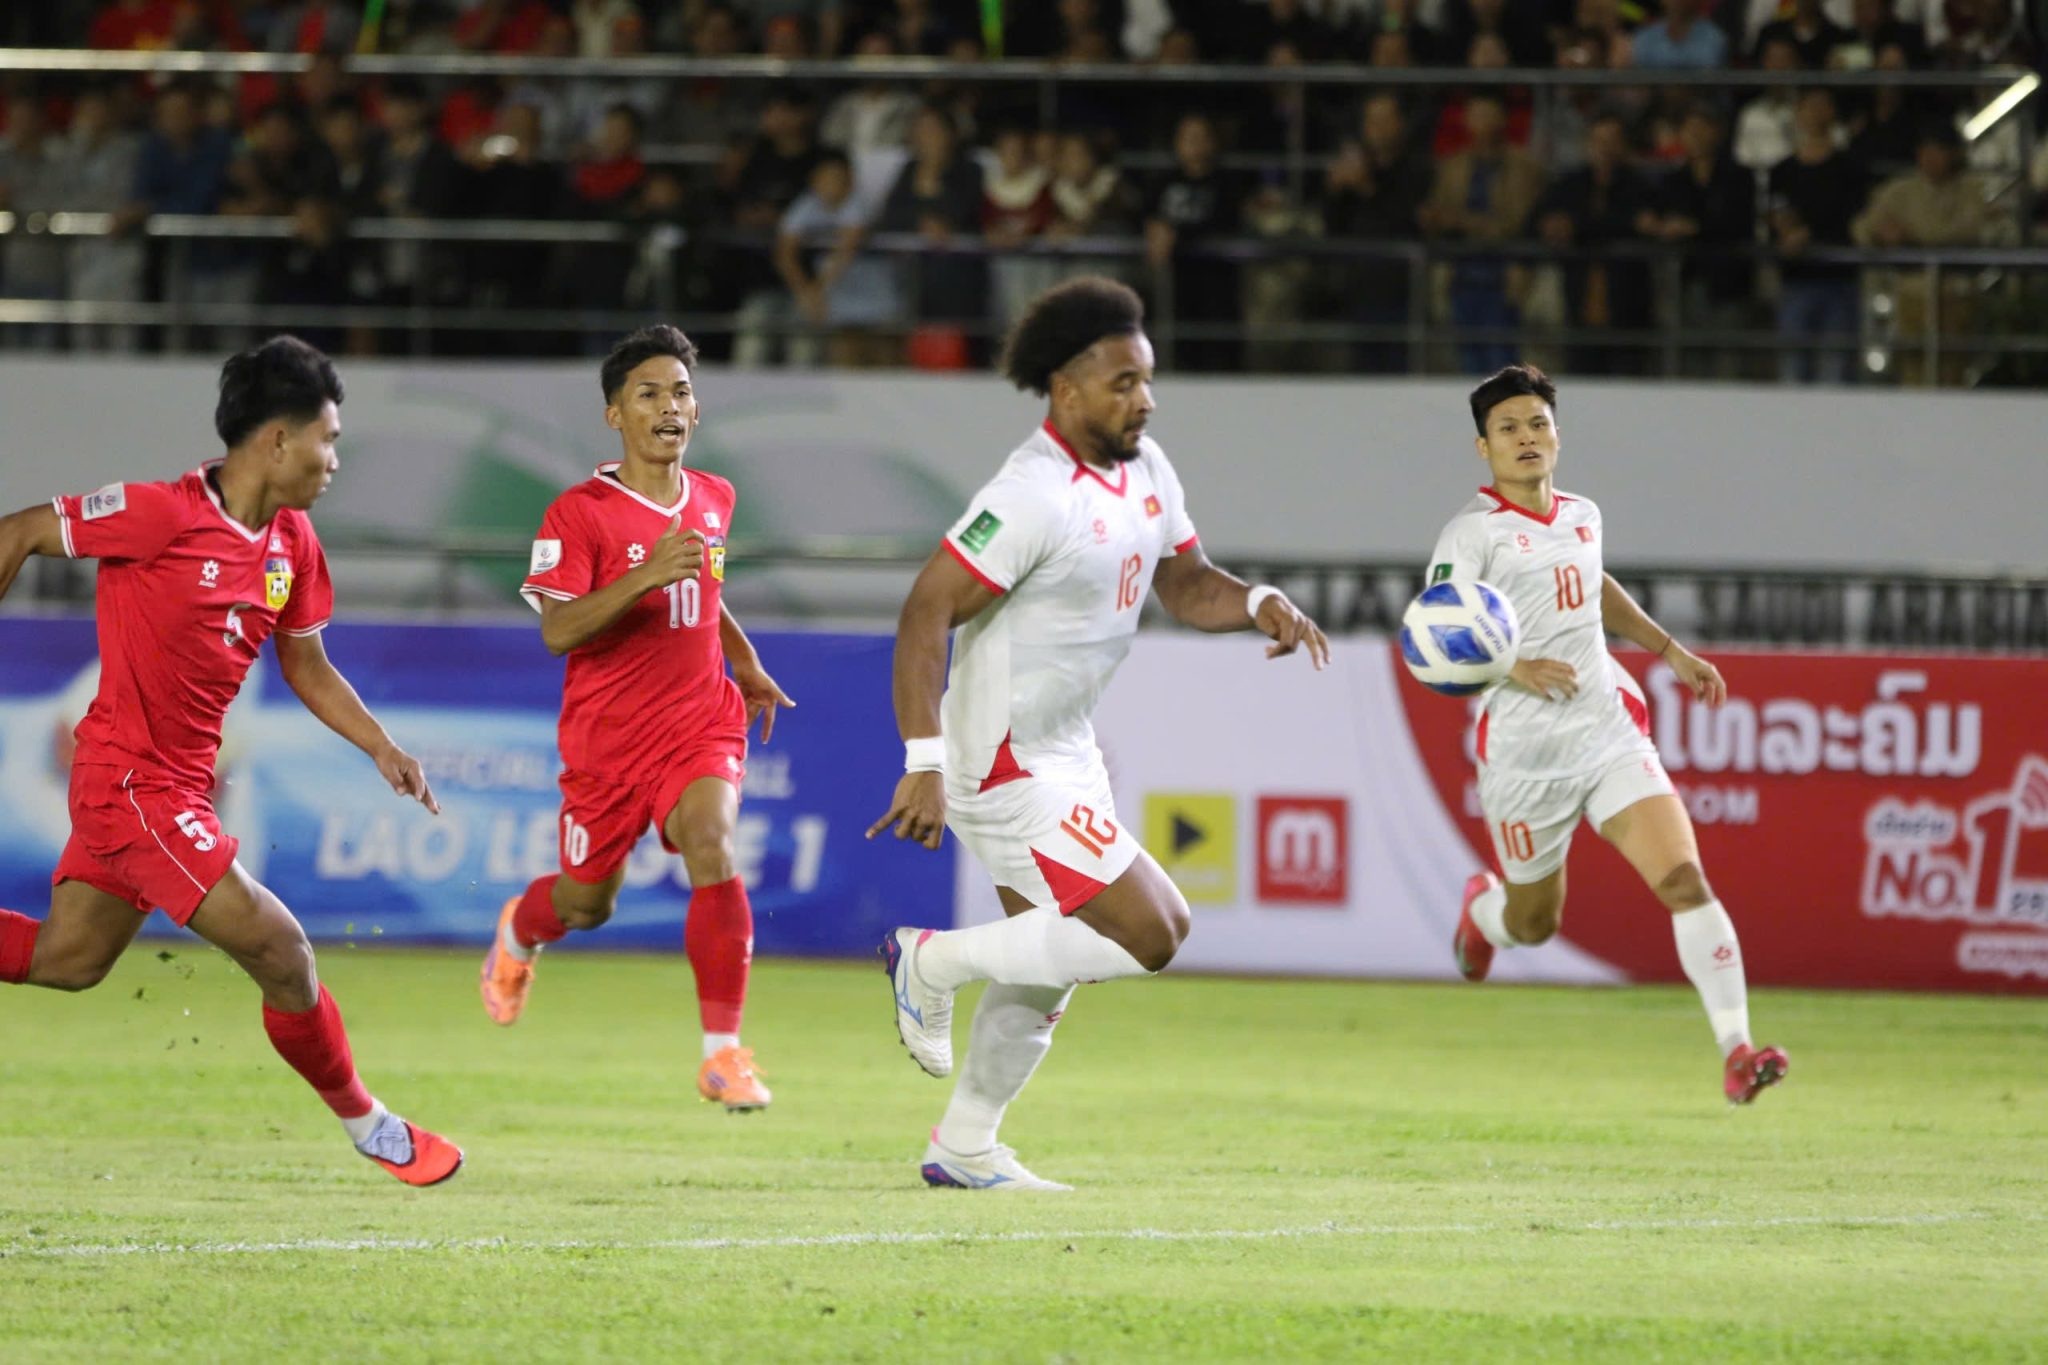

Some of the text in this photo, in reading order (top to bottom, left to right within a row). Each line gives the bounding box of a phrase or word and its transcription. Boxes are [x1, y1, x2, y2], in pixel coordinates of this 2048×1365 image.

[664, 577, 701, 629] 10
[1116, 552, 1143, 613] 12
[1553, 563, 1585, 612] 10
[223, 602, 252, 648] 5
[174, 810, 217, 852] 5
[316, 807, 469, 882] LAO
[789, 815, 828, 893] 1
[563, 812, 590, 867] 10
[1058, 803, 1118, 861] 12
[1501, 820, 1535, 863] 10
